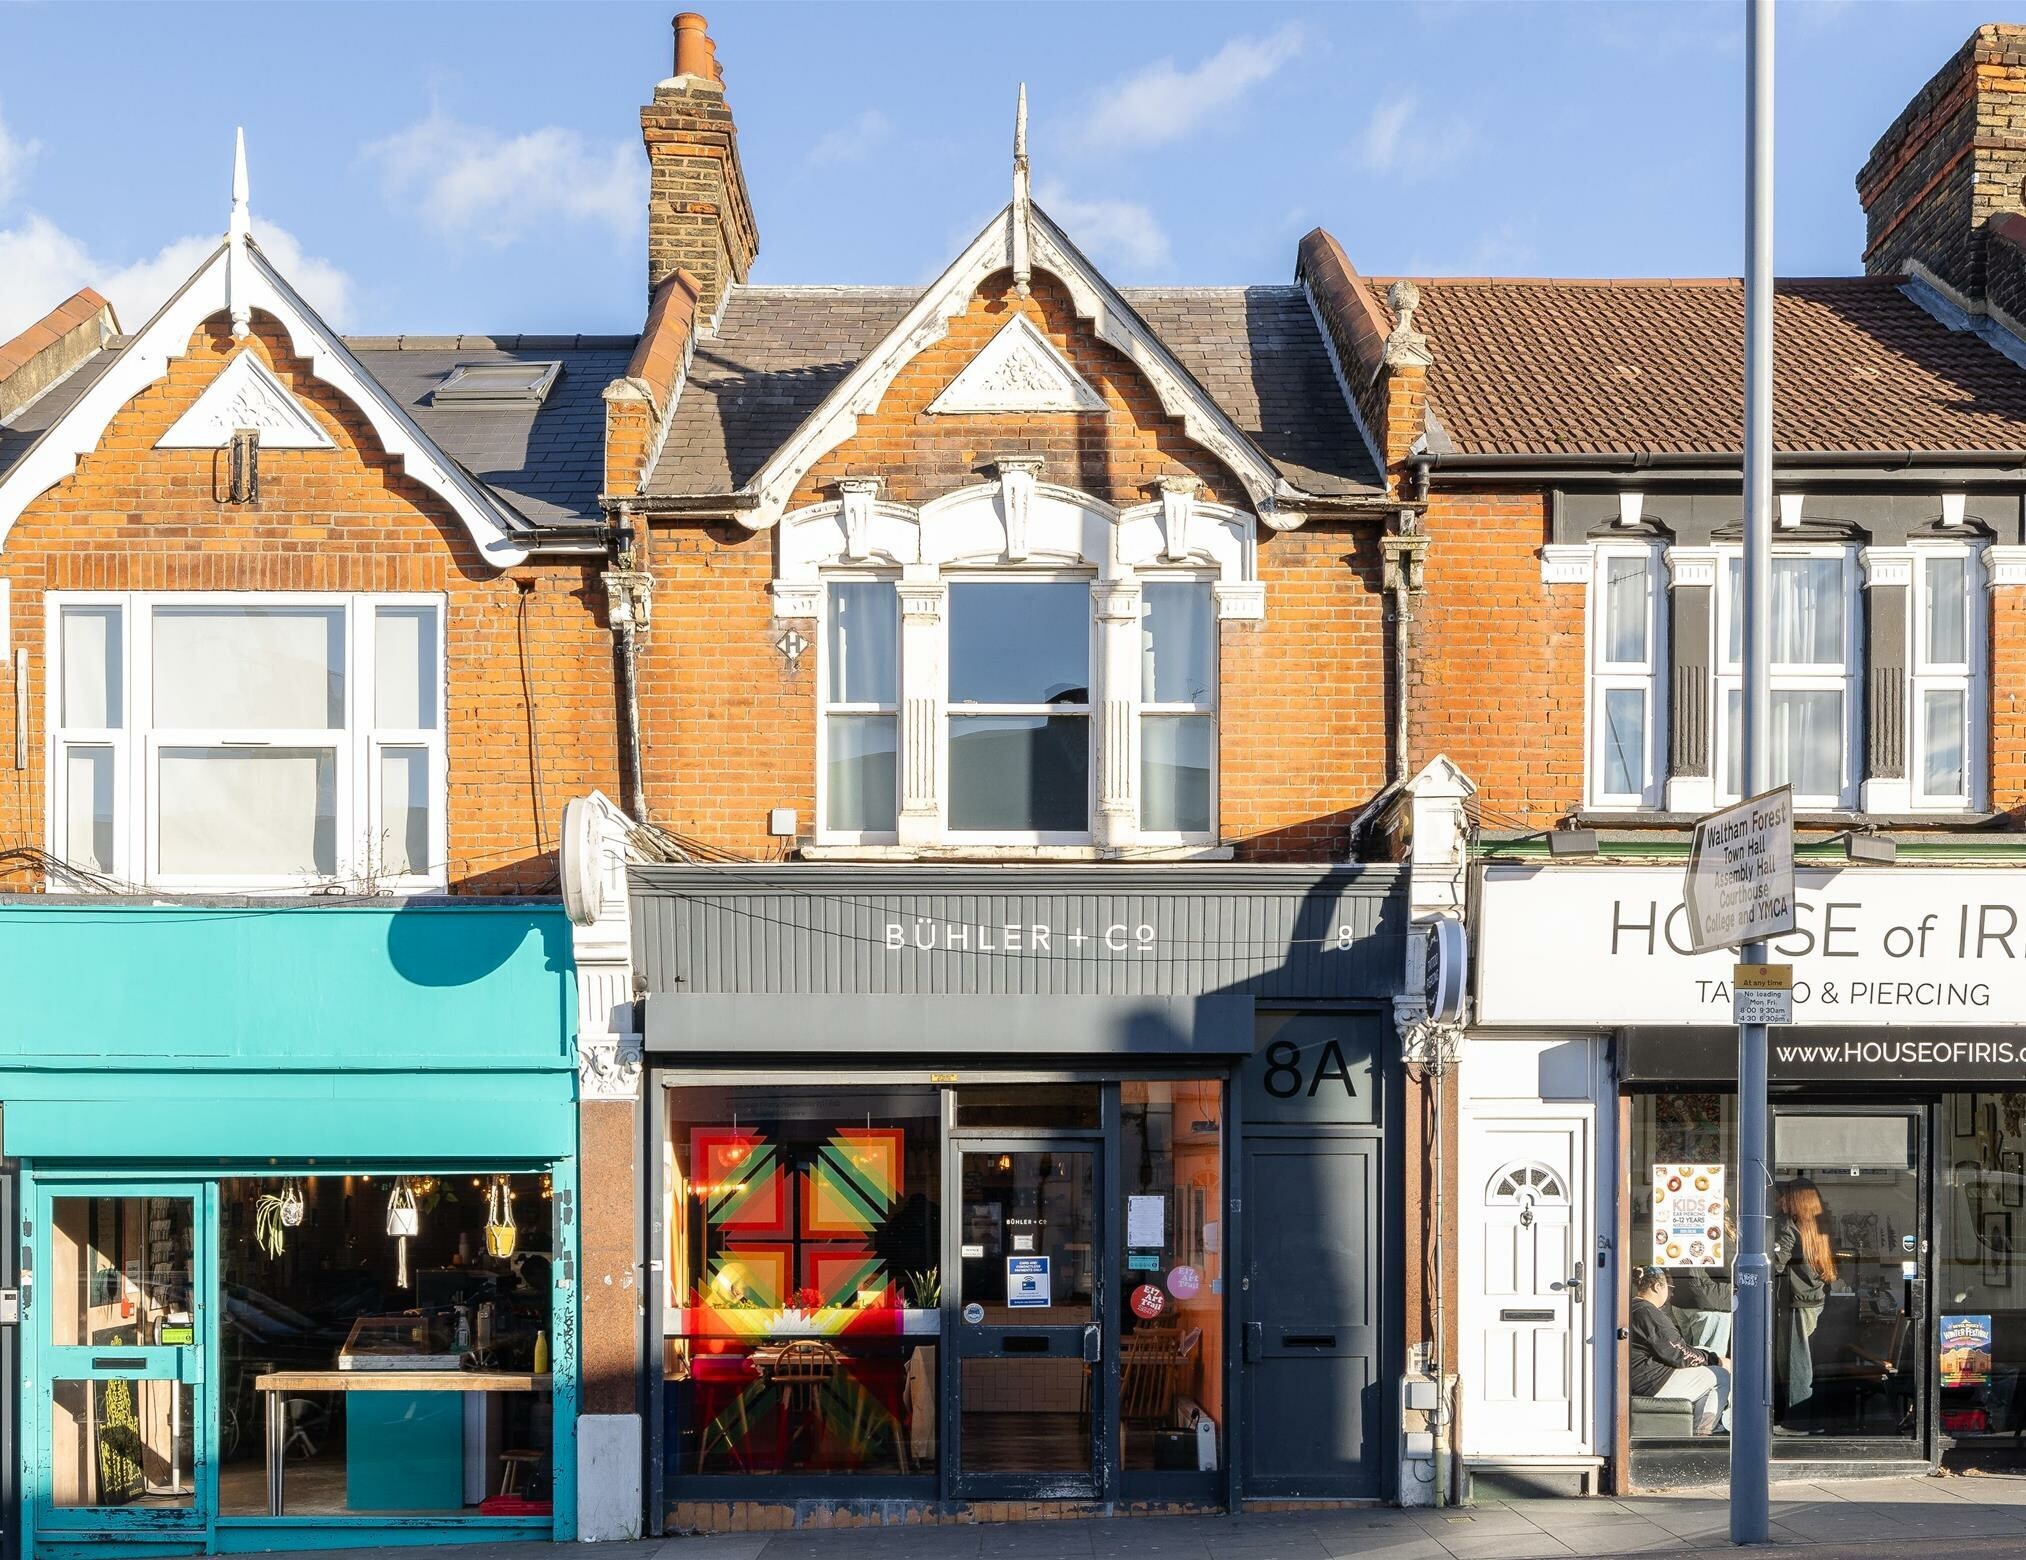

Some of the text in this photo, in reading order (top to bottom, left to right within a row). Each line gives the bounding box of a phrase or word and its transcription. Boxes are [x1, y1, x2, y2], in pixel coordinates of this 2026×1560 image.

[1706, 801, 1786, 848] Waltham Forest
[1723, 835, 1766, 865] Town Hall
[1714, 854, 1776, 889] Assembly Hall
[1719, 882, 1769, 909] Courthouse
[1705, 896, 1788, 934] College and YMCA
[886, 918, 1051, 950] BÜHLER
[1068, 927, 1089, 948] +
[1337, 925, 1354, 952] 8
[1883, 914, 1938, 958] of
[1820, 981, 1840, 1005] &
[1850, 982, 1991, 1006] PIERCING
[1263, 1040, 1358, 1099] 8A
[1672, 1199, 1706, 1212] KIDS
[1178, 1267, 1195, 1275] E17
[1182, 1274, 1199, 1282] Art
[1143, 1285, 1161, 1296] E17
[1144, 1293, 1164, 1303] Art
[1178, 1281, 1199, 1289] Trail
[1140, 1298, 1162, 1311] Trail
